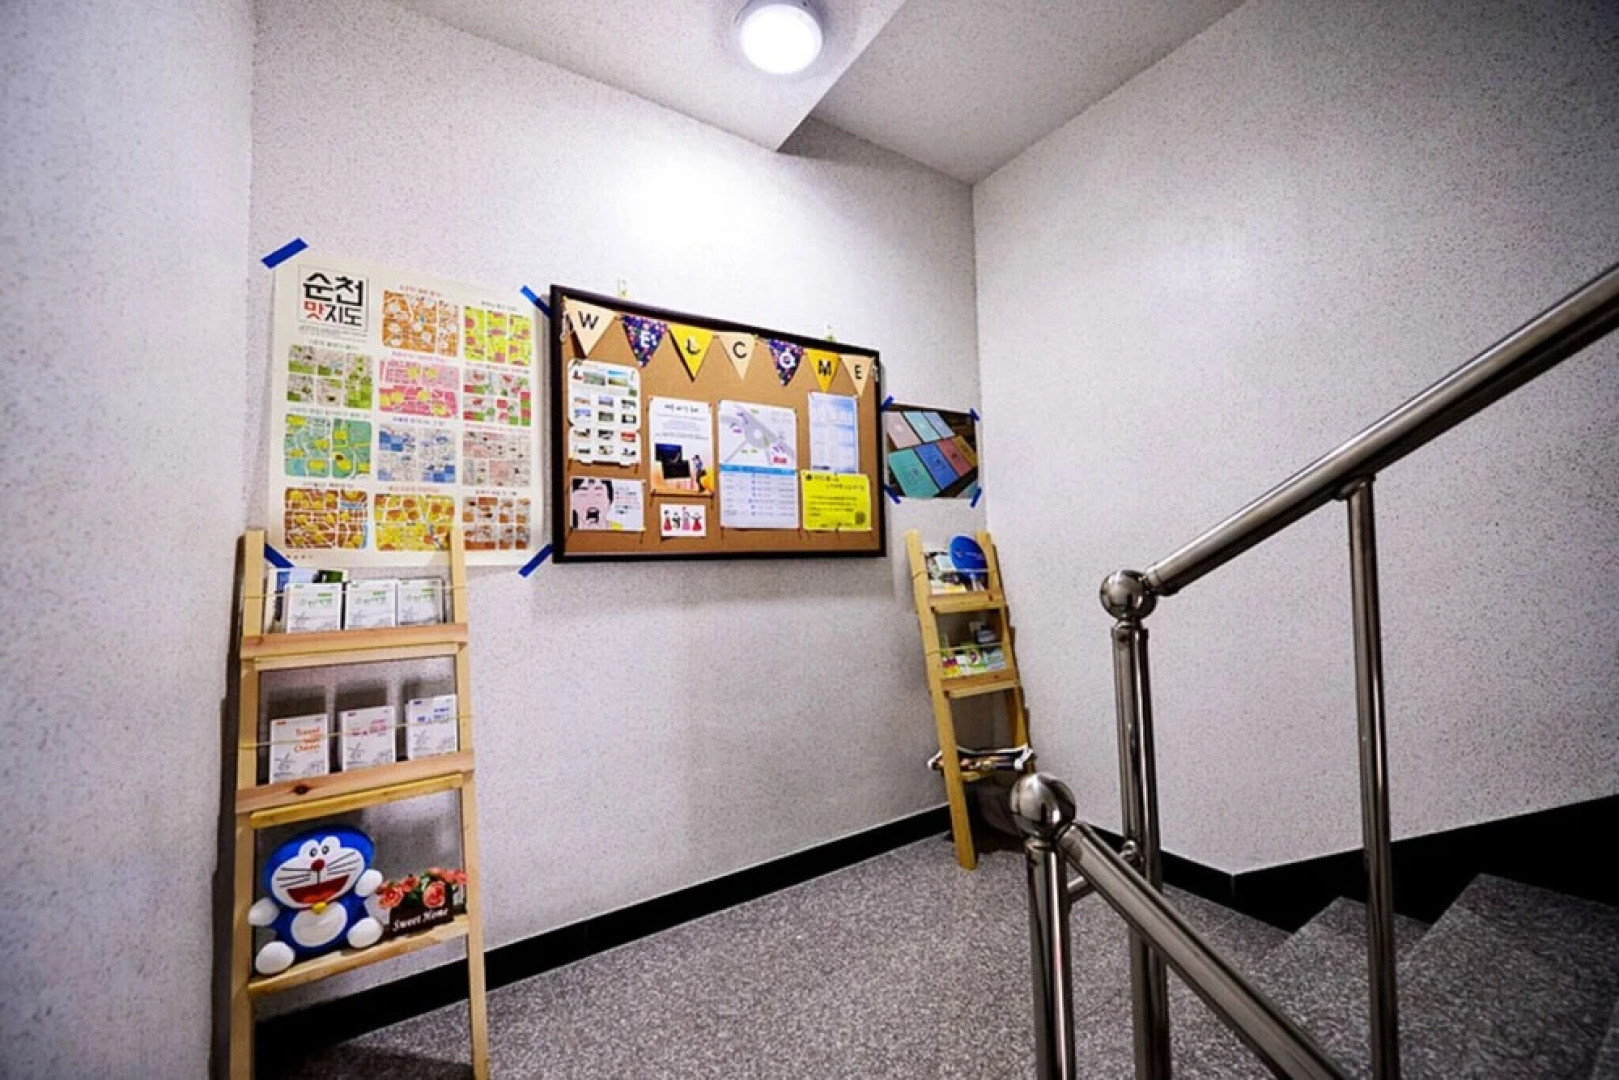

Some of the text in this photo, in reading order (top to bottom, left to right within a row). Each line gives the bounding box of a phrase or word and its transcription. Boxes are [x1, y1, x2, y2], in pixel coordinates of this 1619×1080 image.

[303, 271, 364, 307] 순천
[303, 301, 362, 327] 맛지도
[577, 310, 863, 380] WELCOME
